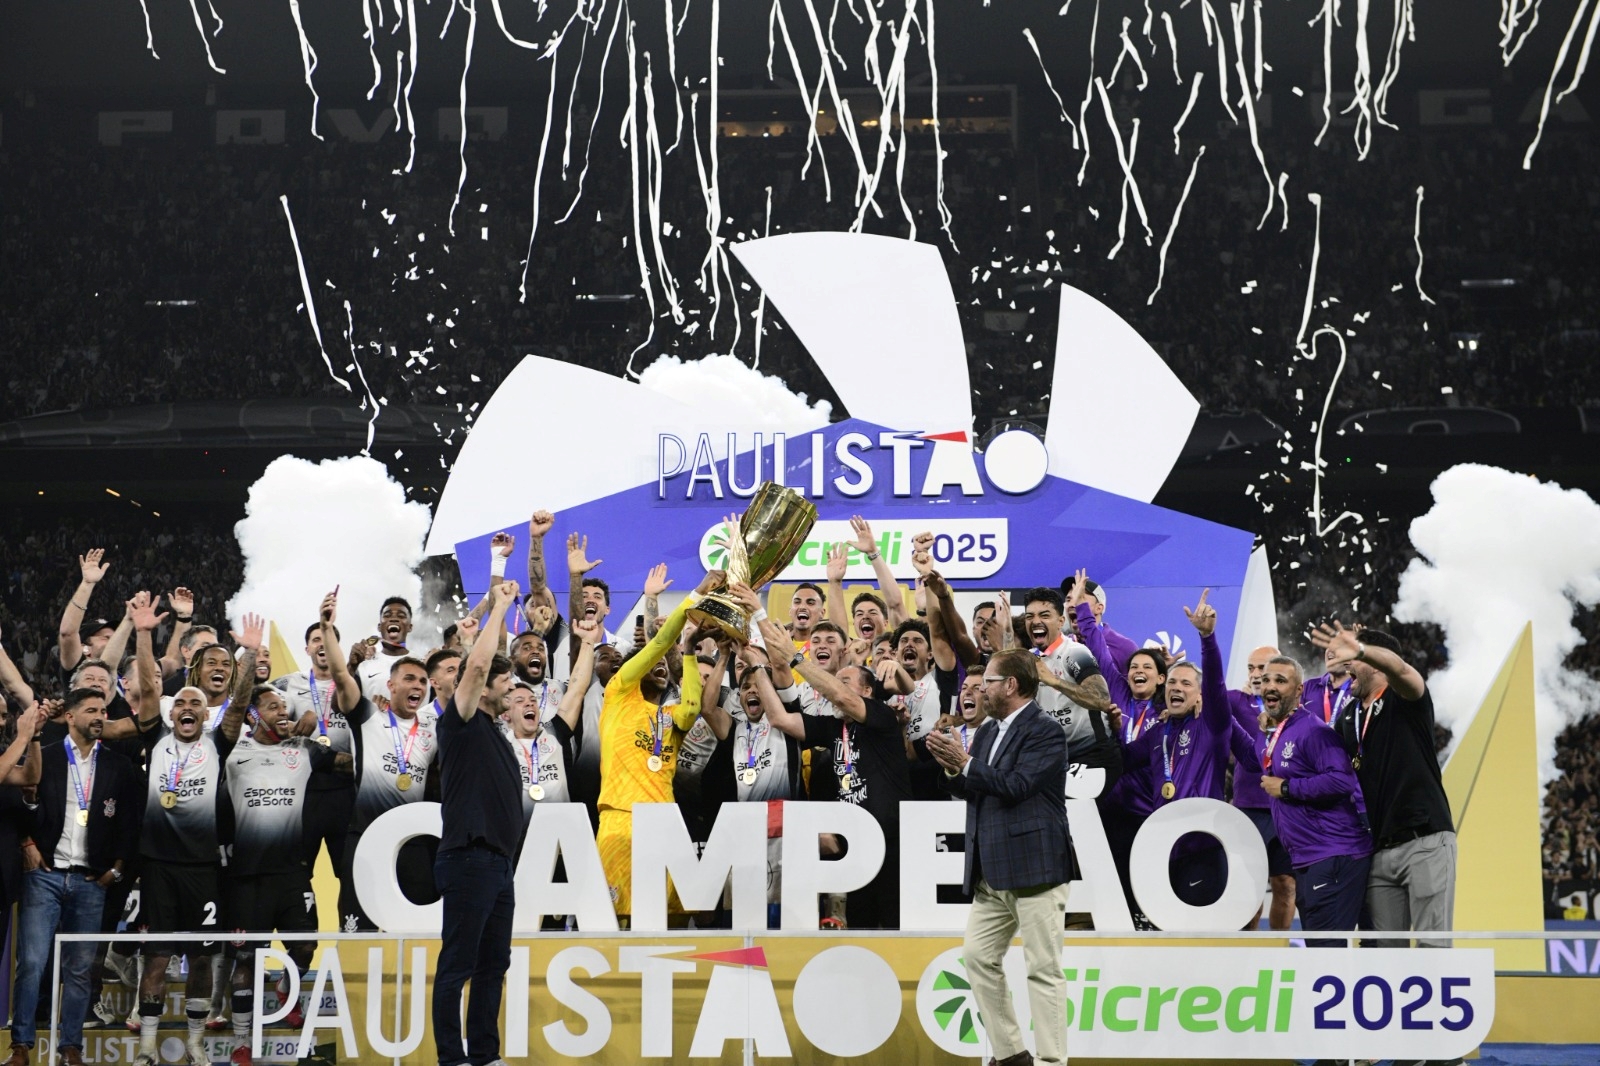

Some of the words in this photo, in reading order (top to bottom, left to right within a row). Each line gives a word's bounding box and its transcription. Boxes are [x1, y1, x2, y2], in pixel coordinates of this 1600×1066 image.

[911, 533, 997, 563] 025
[243, 787, 296, 799] Esportes
[247, 797, 261, 808] da
[262, 796, 293, 807] Sorte
[202, 901, 217, 926] 2
[252, 944, 902, 1059] PAUISTÃO
[1311, 974, 1475, 1032] 2025
